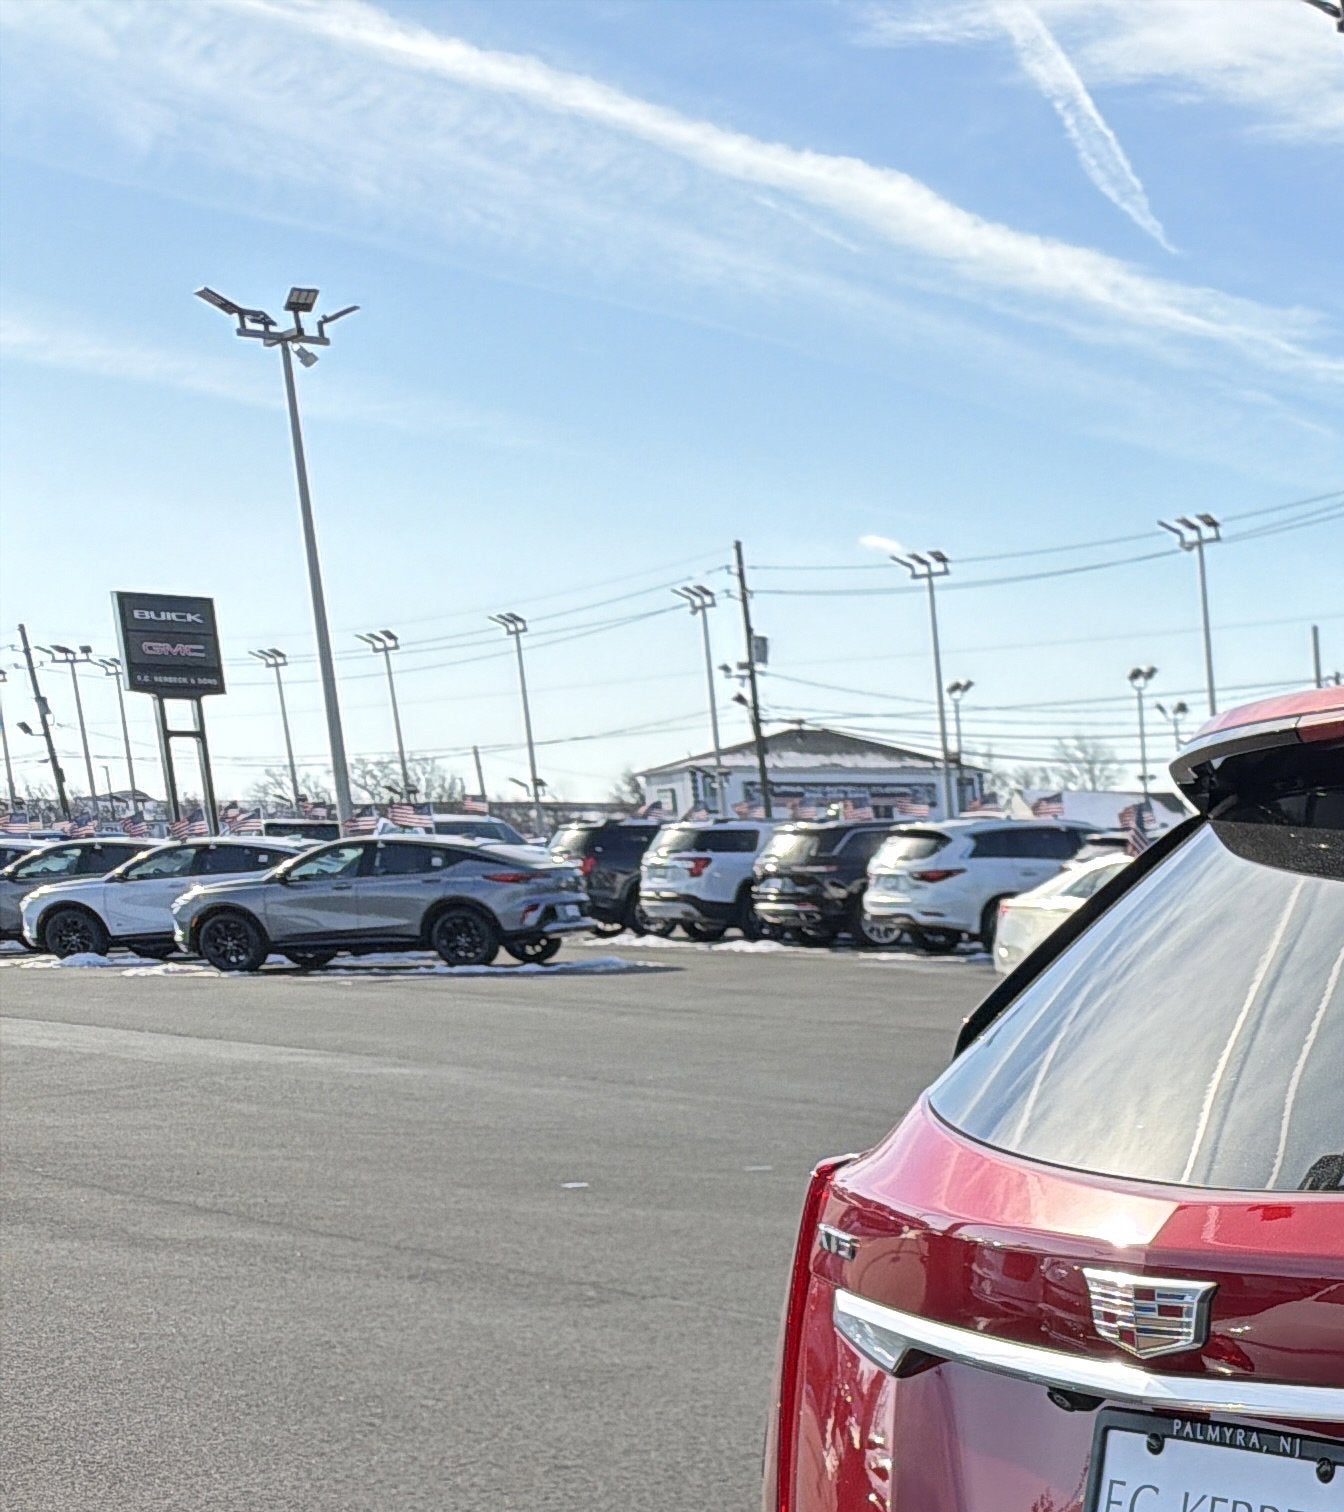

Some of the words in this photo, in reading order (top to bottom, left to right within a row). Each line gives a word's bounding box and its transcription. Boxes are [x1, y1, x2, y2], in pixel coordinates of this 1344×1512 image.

[132, 609, 204, 624] BUICK
[141, 641, 206, 658] GMC
[1172, 1419, 1270, 1453] PALMYRA,
[1278, 1435, 1301, 1458] NJ
